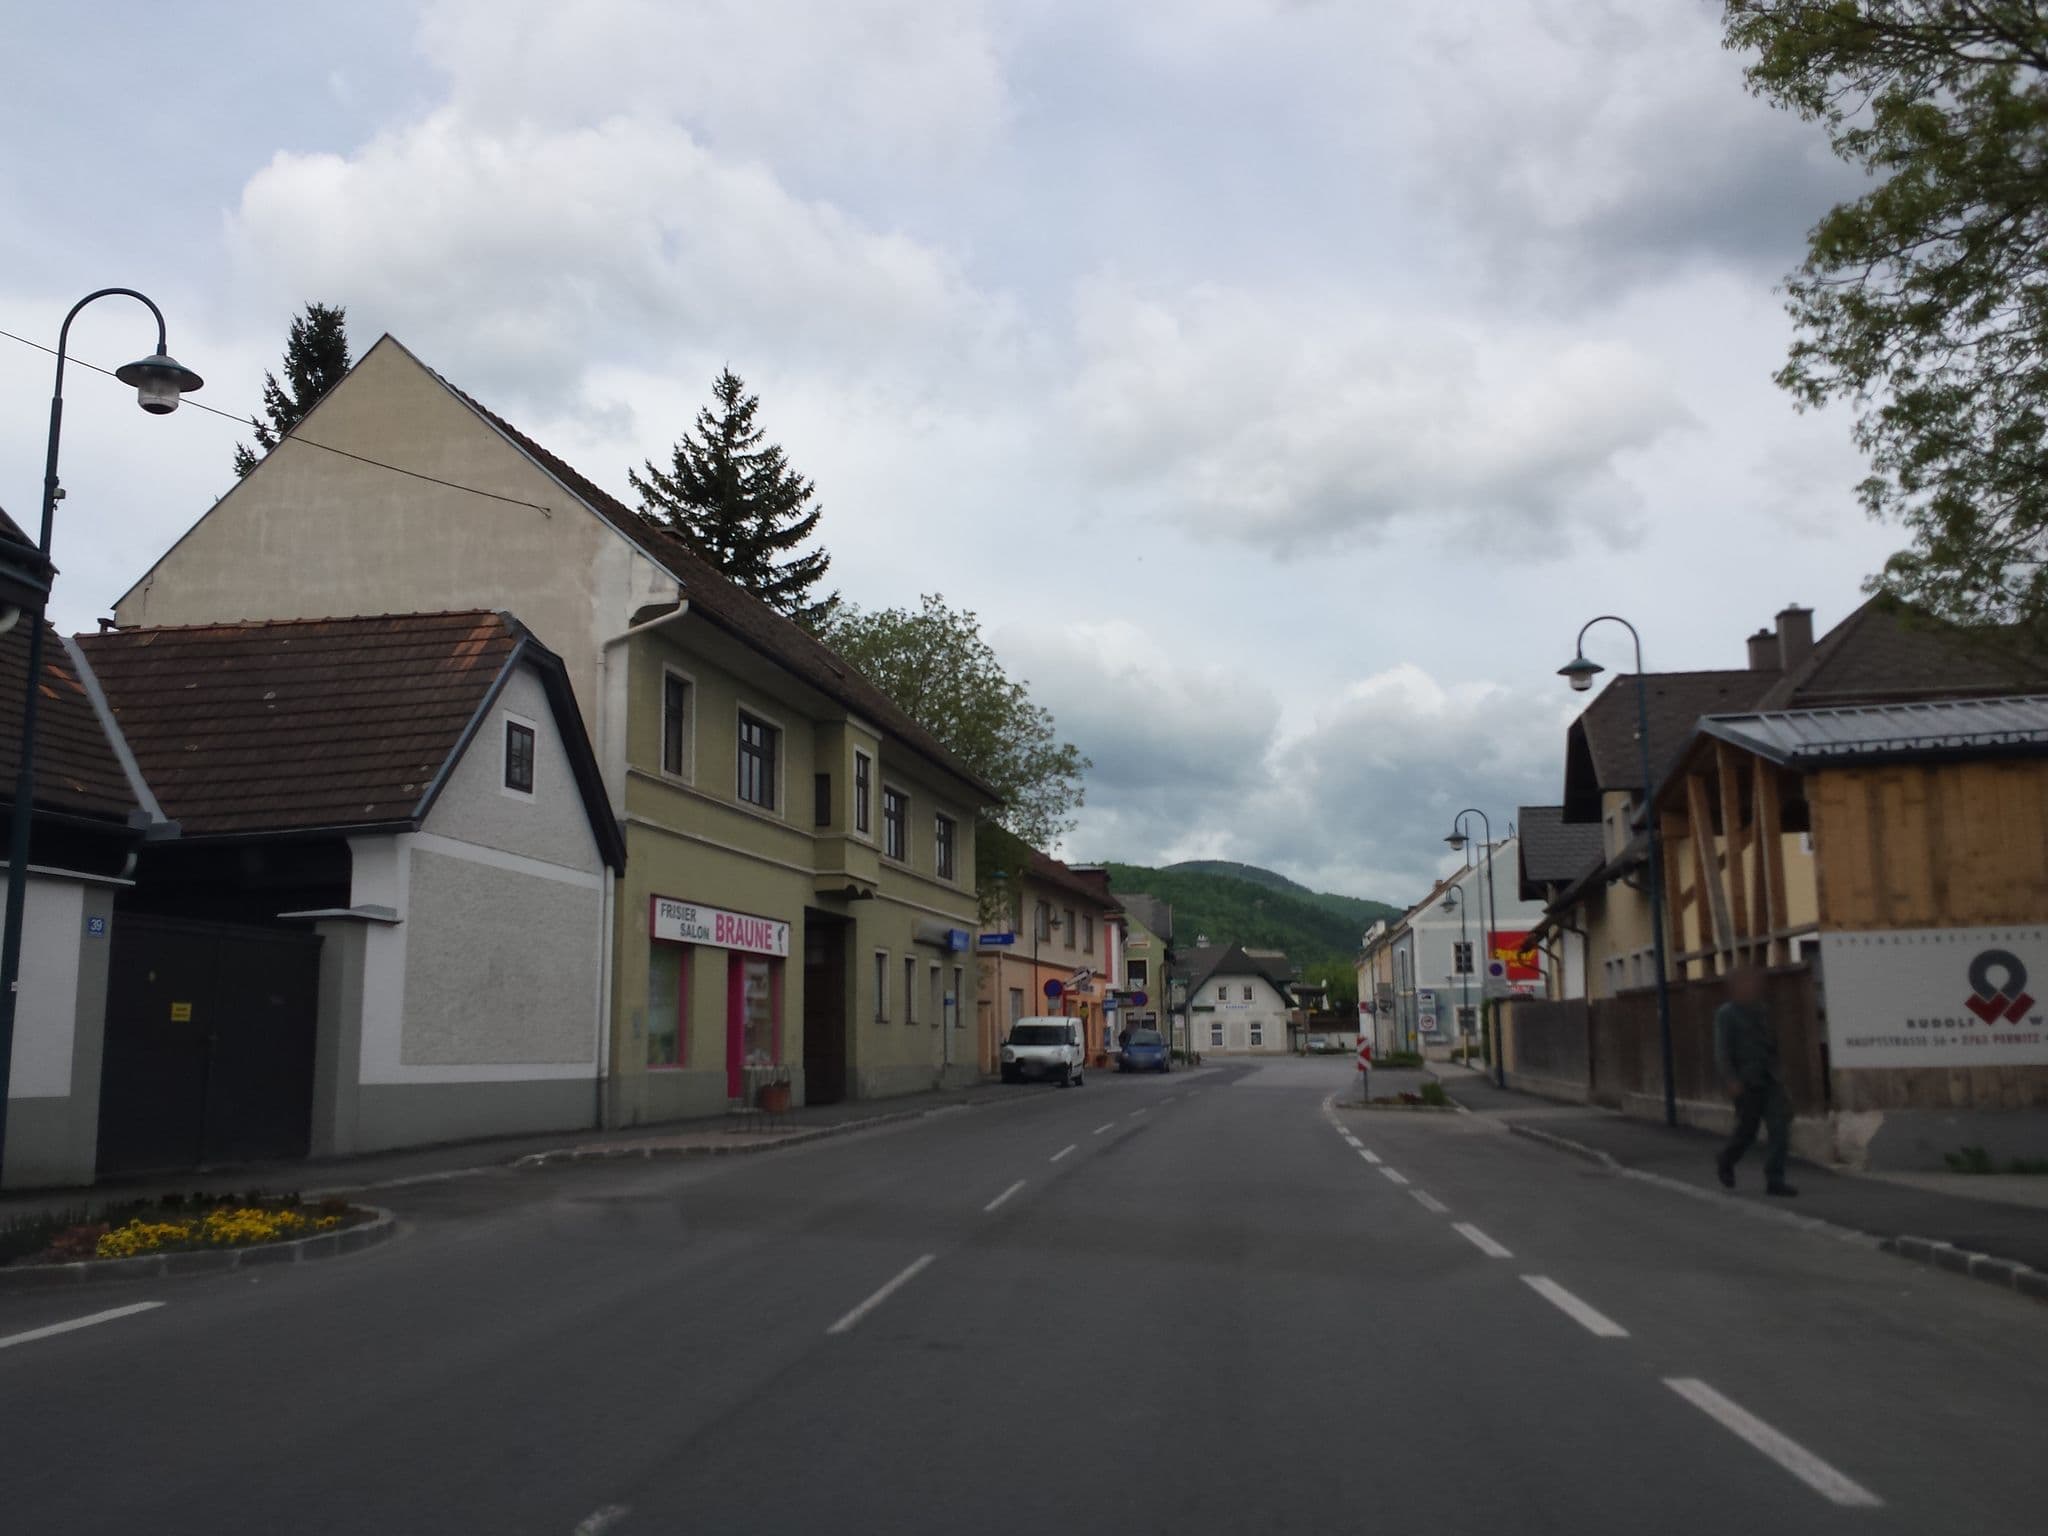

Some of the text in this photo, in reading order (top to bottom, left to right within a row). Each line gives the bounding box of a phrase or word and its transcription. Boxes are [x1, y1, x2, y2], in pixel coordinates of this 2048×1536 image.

[660, 903, 697, 922] FRISIER
[90, 919, 103, 931] 39
[680, 923, 710, 940] SALON
[715, 914, 773, 950] BRAUNE
[1907, 1017, 1975, 1028] RUDOLF
